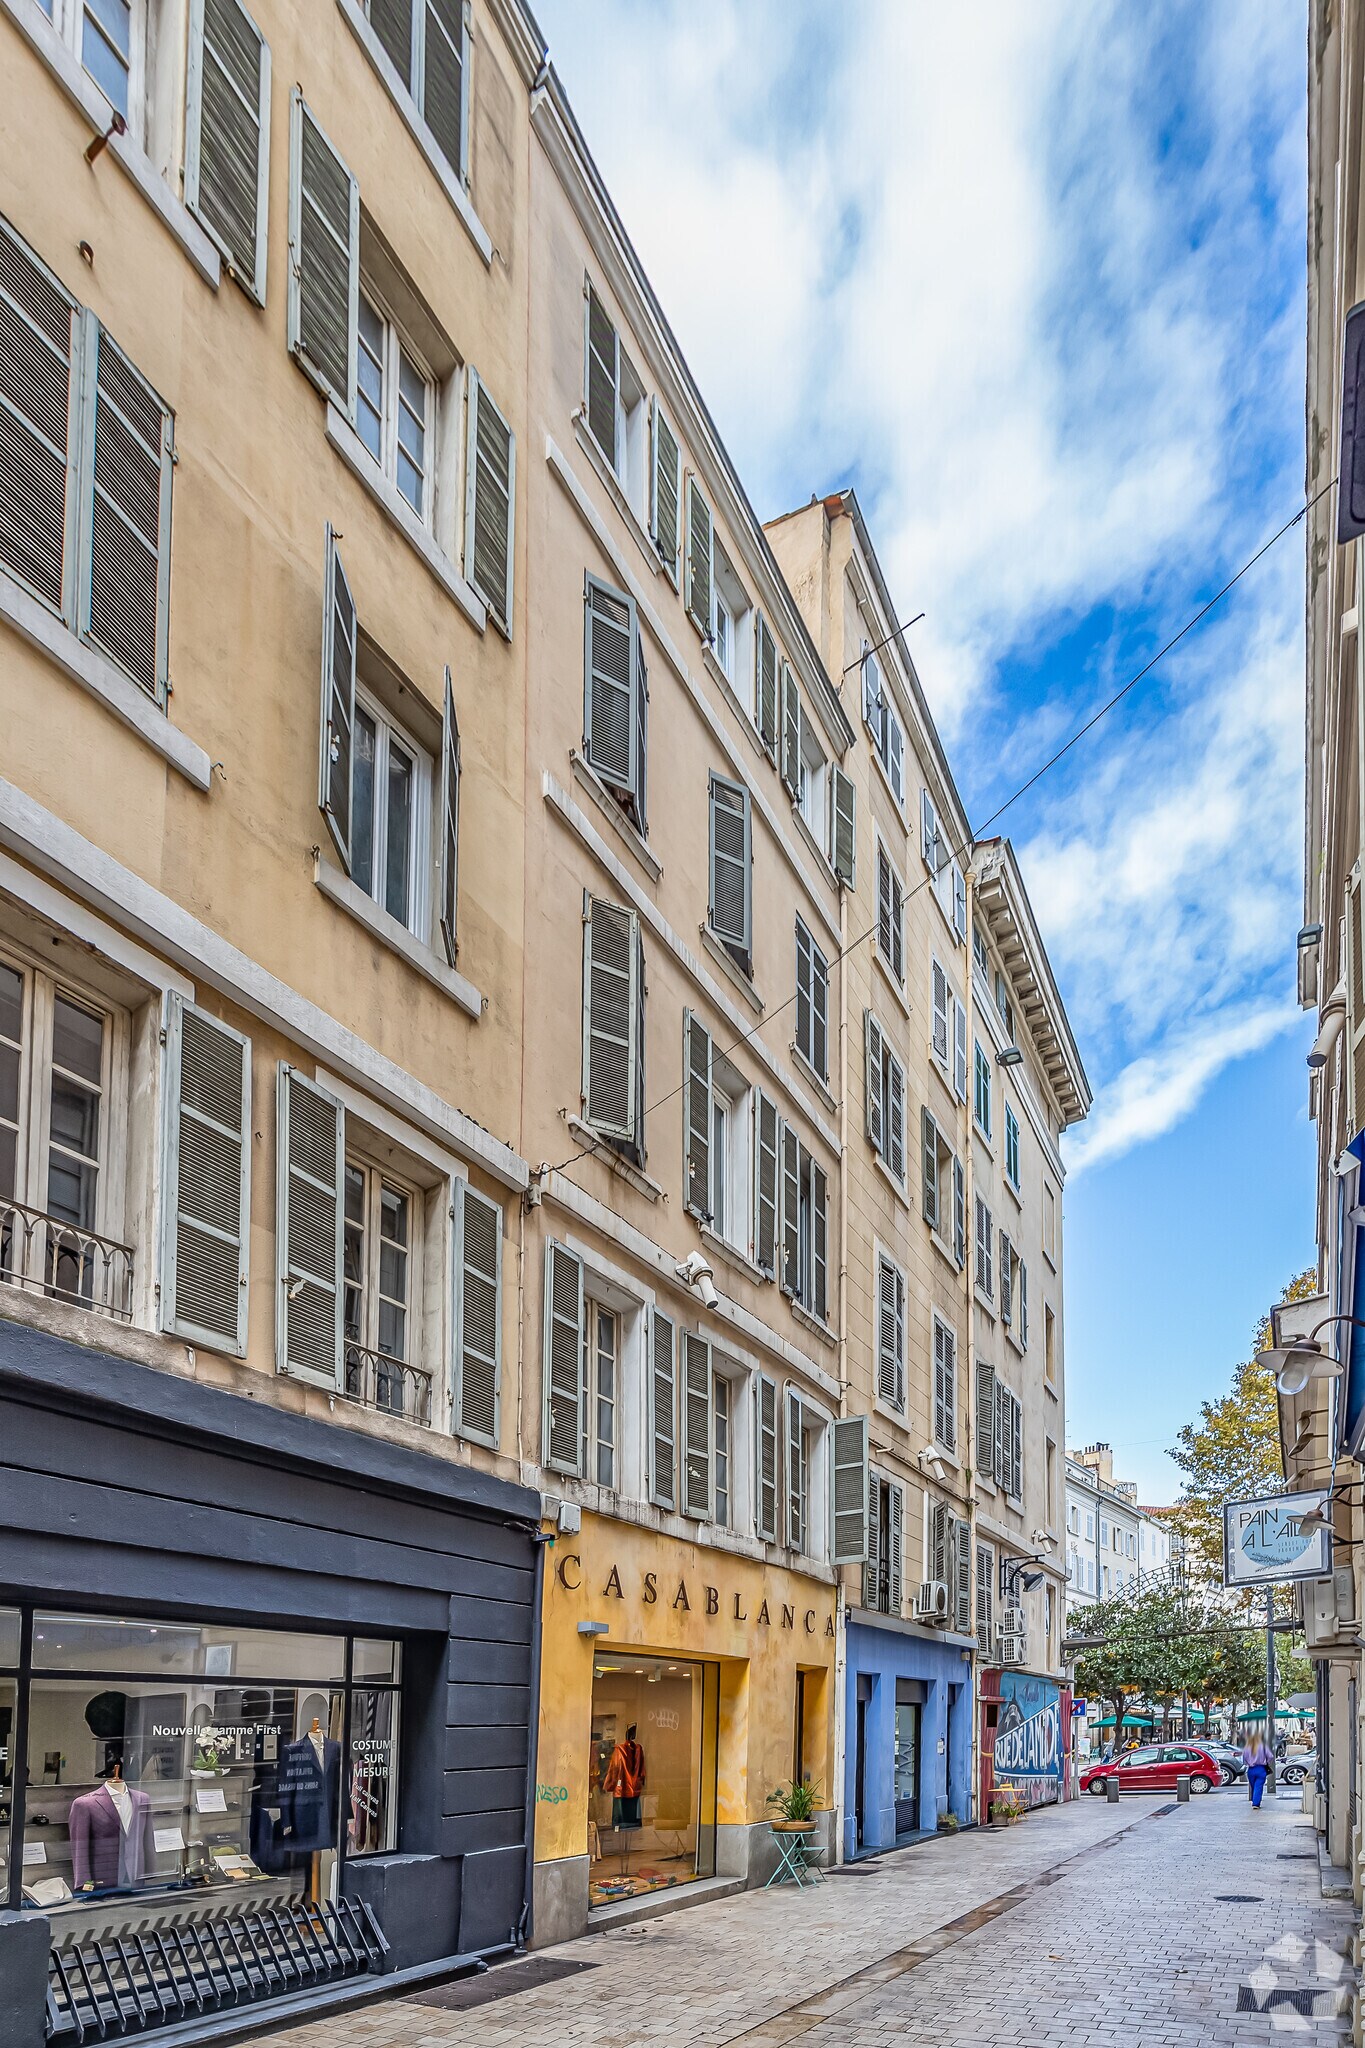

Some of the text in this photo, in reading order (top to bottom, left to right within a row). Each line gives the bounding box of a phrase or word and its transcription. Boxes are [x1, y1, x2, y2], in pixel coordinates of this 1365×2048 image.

[1239, 1508, 1278, 1528] PAIN
[558, 1554, 836, 1638] CASABLANCA
[218, 1726, 254, 1736] amme
[352, 1740, 397, 1750] COSTUME
[996, 1734, 1011, 1769] RUE
[1011, 1726, 1024, 1770] DE
[363, 1753, 384, 1764] SUR
[353, 1766, 394, 1778] MESURE
